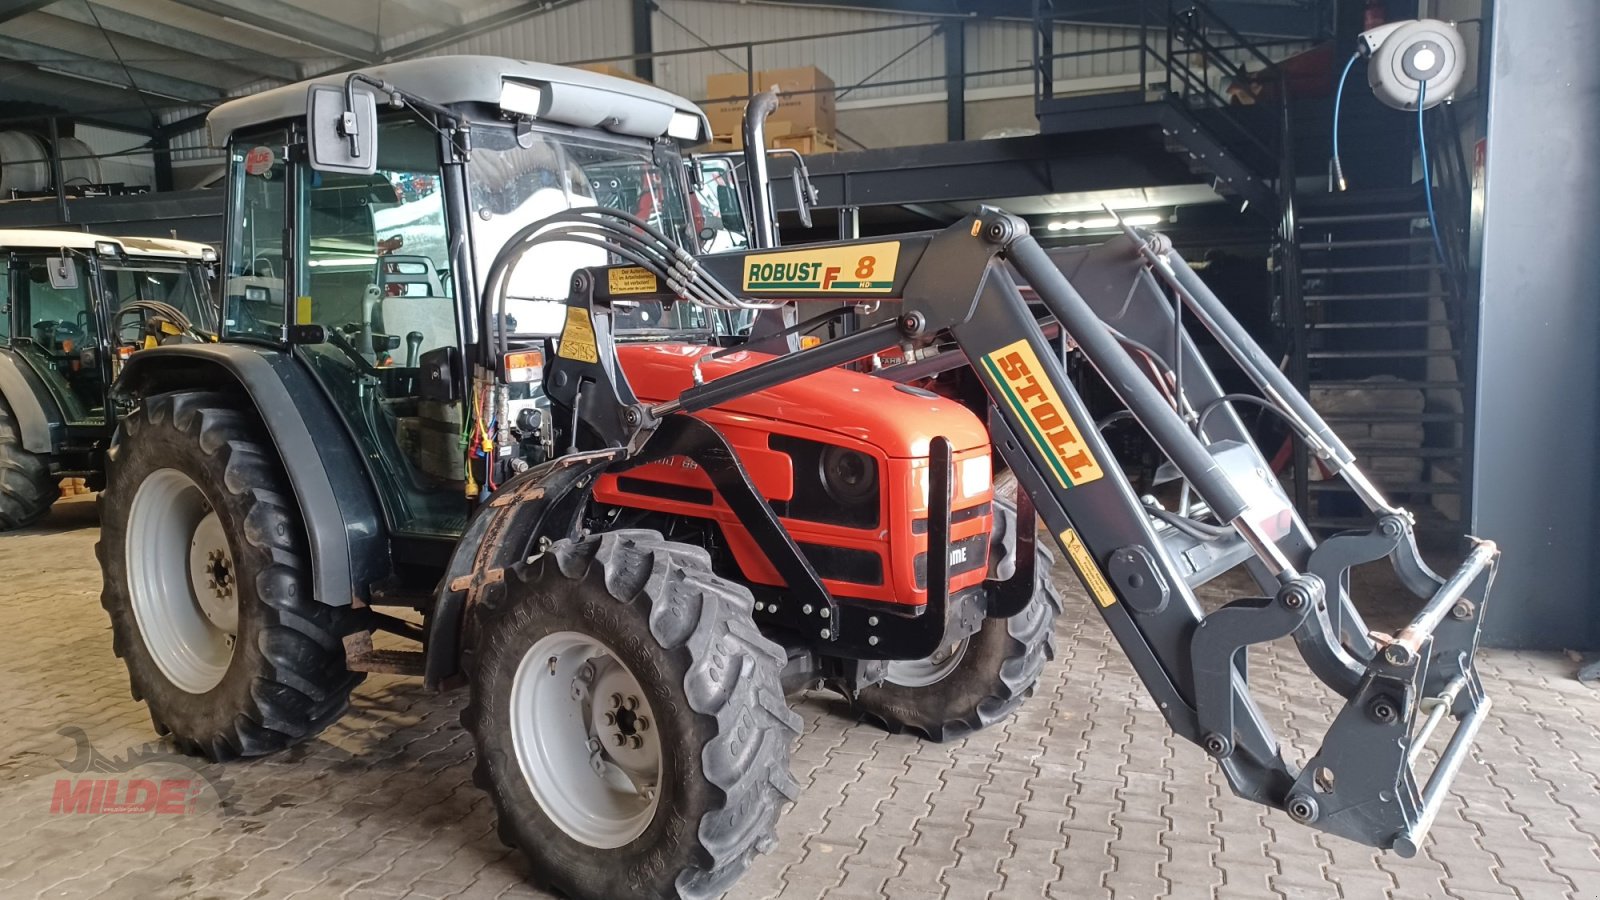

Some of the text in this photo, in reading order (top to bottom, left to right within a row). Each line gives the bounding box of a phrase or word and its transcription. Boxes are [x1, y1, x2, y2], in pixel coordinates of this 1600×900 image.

[749, 255, 876, 290] ROBUST F 8
[997, 351, 1093, 479] STOLL
